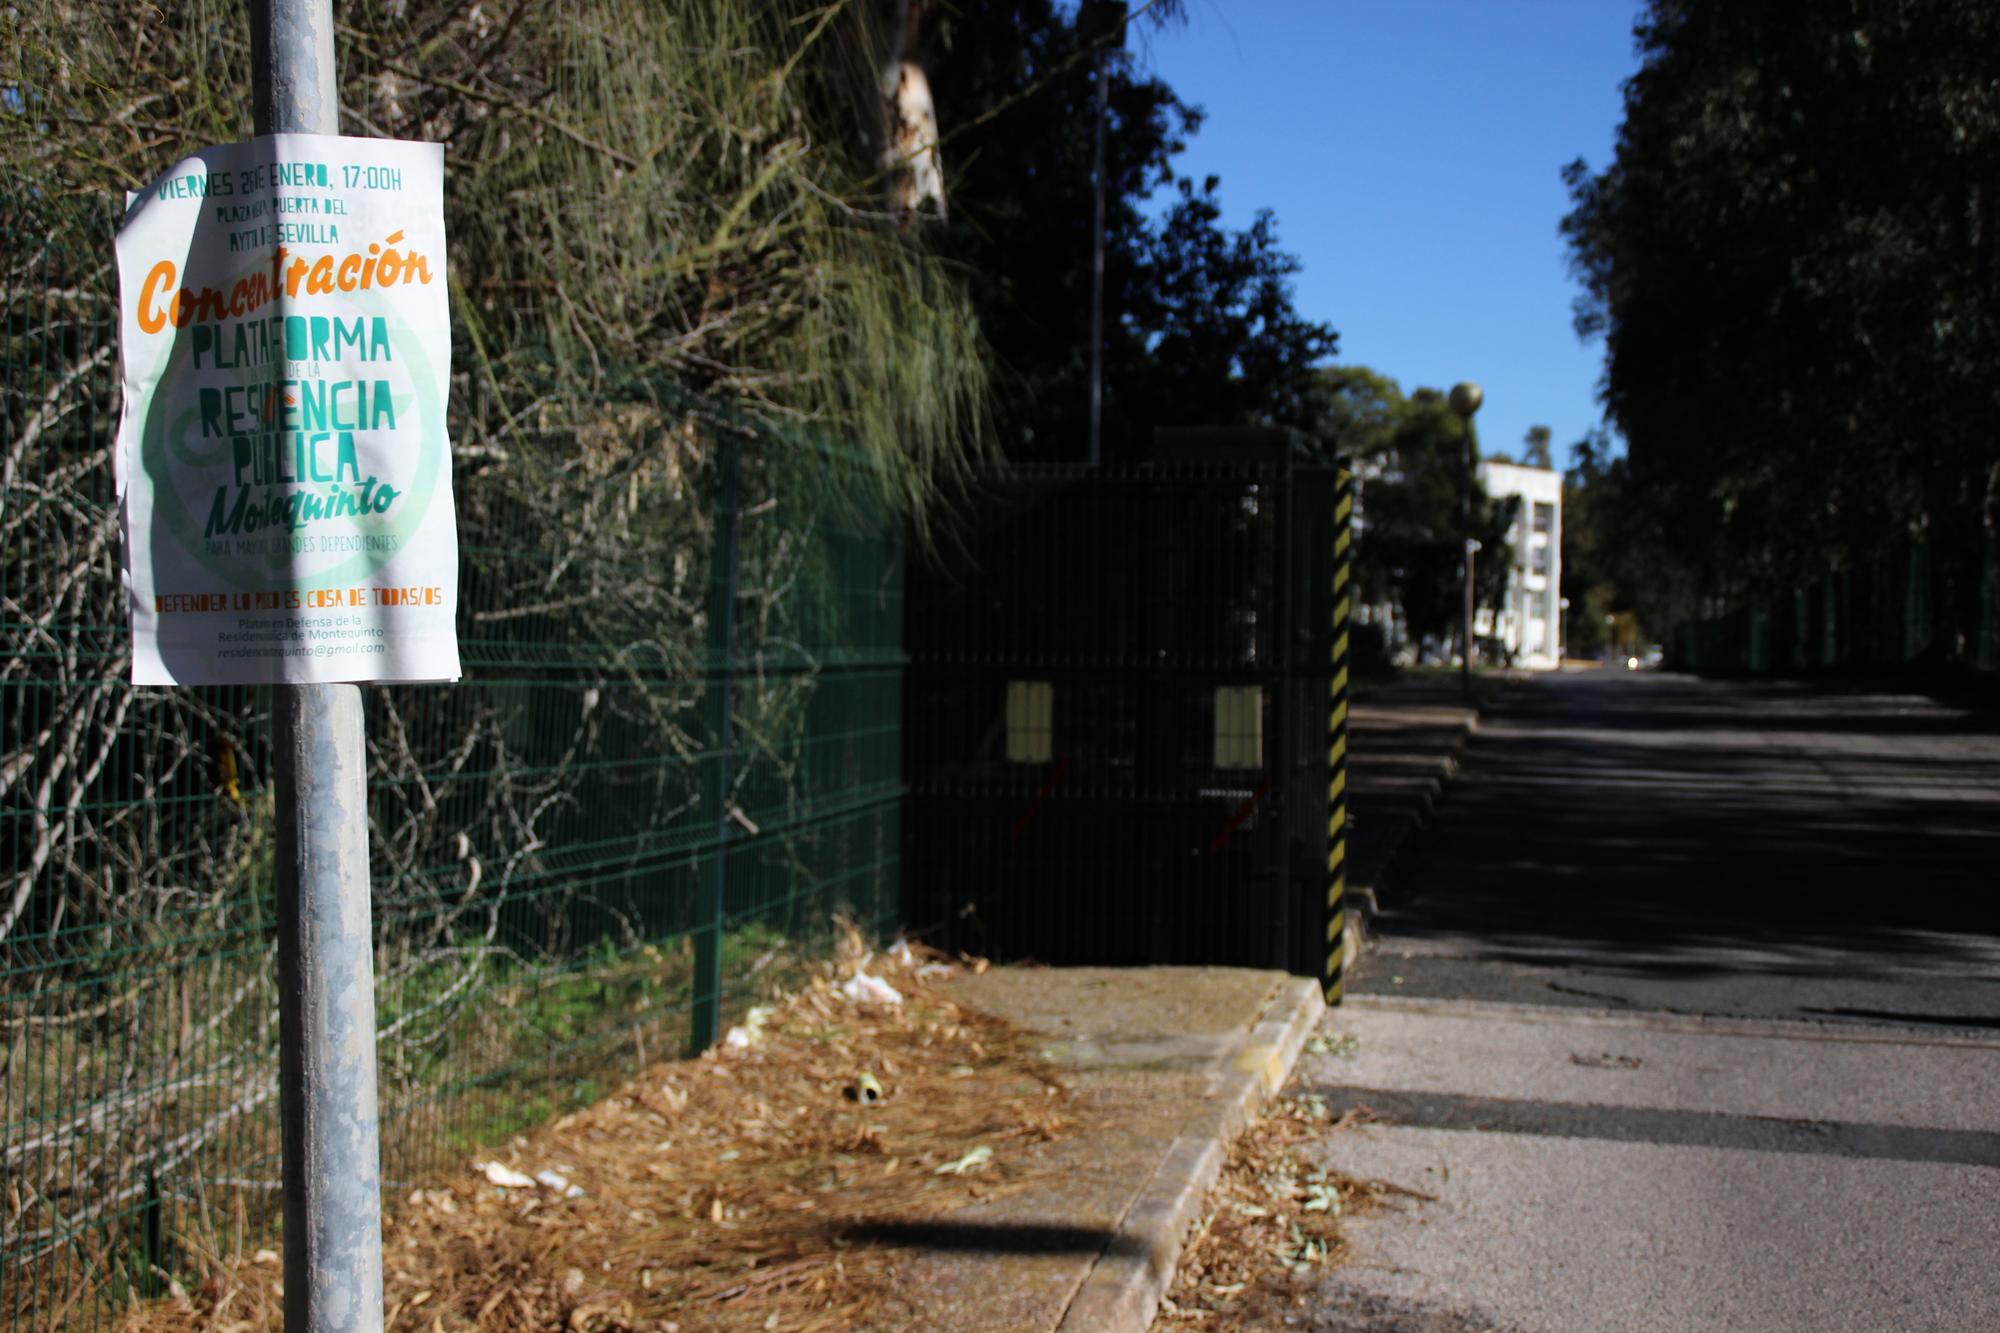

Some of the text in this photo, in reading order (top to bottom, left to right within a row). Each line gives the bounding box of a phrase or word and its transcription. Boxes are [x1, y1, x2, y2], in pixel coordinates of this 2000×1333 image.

[159, 172, 234, 201] VIERNES
[269, 162, 334, 191] ENERO,
[342, 165, 402, 190] 17:00H
[216, 204, 250, 223] PLAZA
[272, 197, 320, 214] PUERTA
[325, 198, 348, 215] DEL
[276, 223, 339, 244] SEVILLA
[137, 229, 433, 334] Concentración
[192, 315, 392, 370] PLATAFORMA
[308, 361, 320, 378] LA
[204, 474, 402, 539] Montequinto
[320, 534, 399, 554] DEPENDIENTES
[154, 592, 228, 614] DEFENDER
[232, 591, 251, 611] LO
[283, 590, 302, 610] ES
[306, 588, 344, 609] COSA
[349, 587, 367, 607] DE
[372, 585, 442, 607] TODAS/OS
[286, 615, 333, 628] Defensa
[335, 616, 350, 627] de
[352, 615, 362, 626] la
[308, 626, 385, 641] Montequinto
